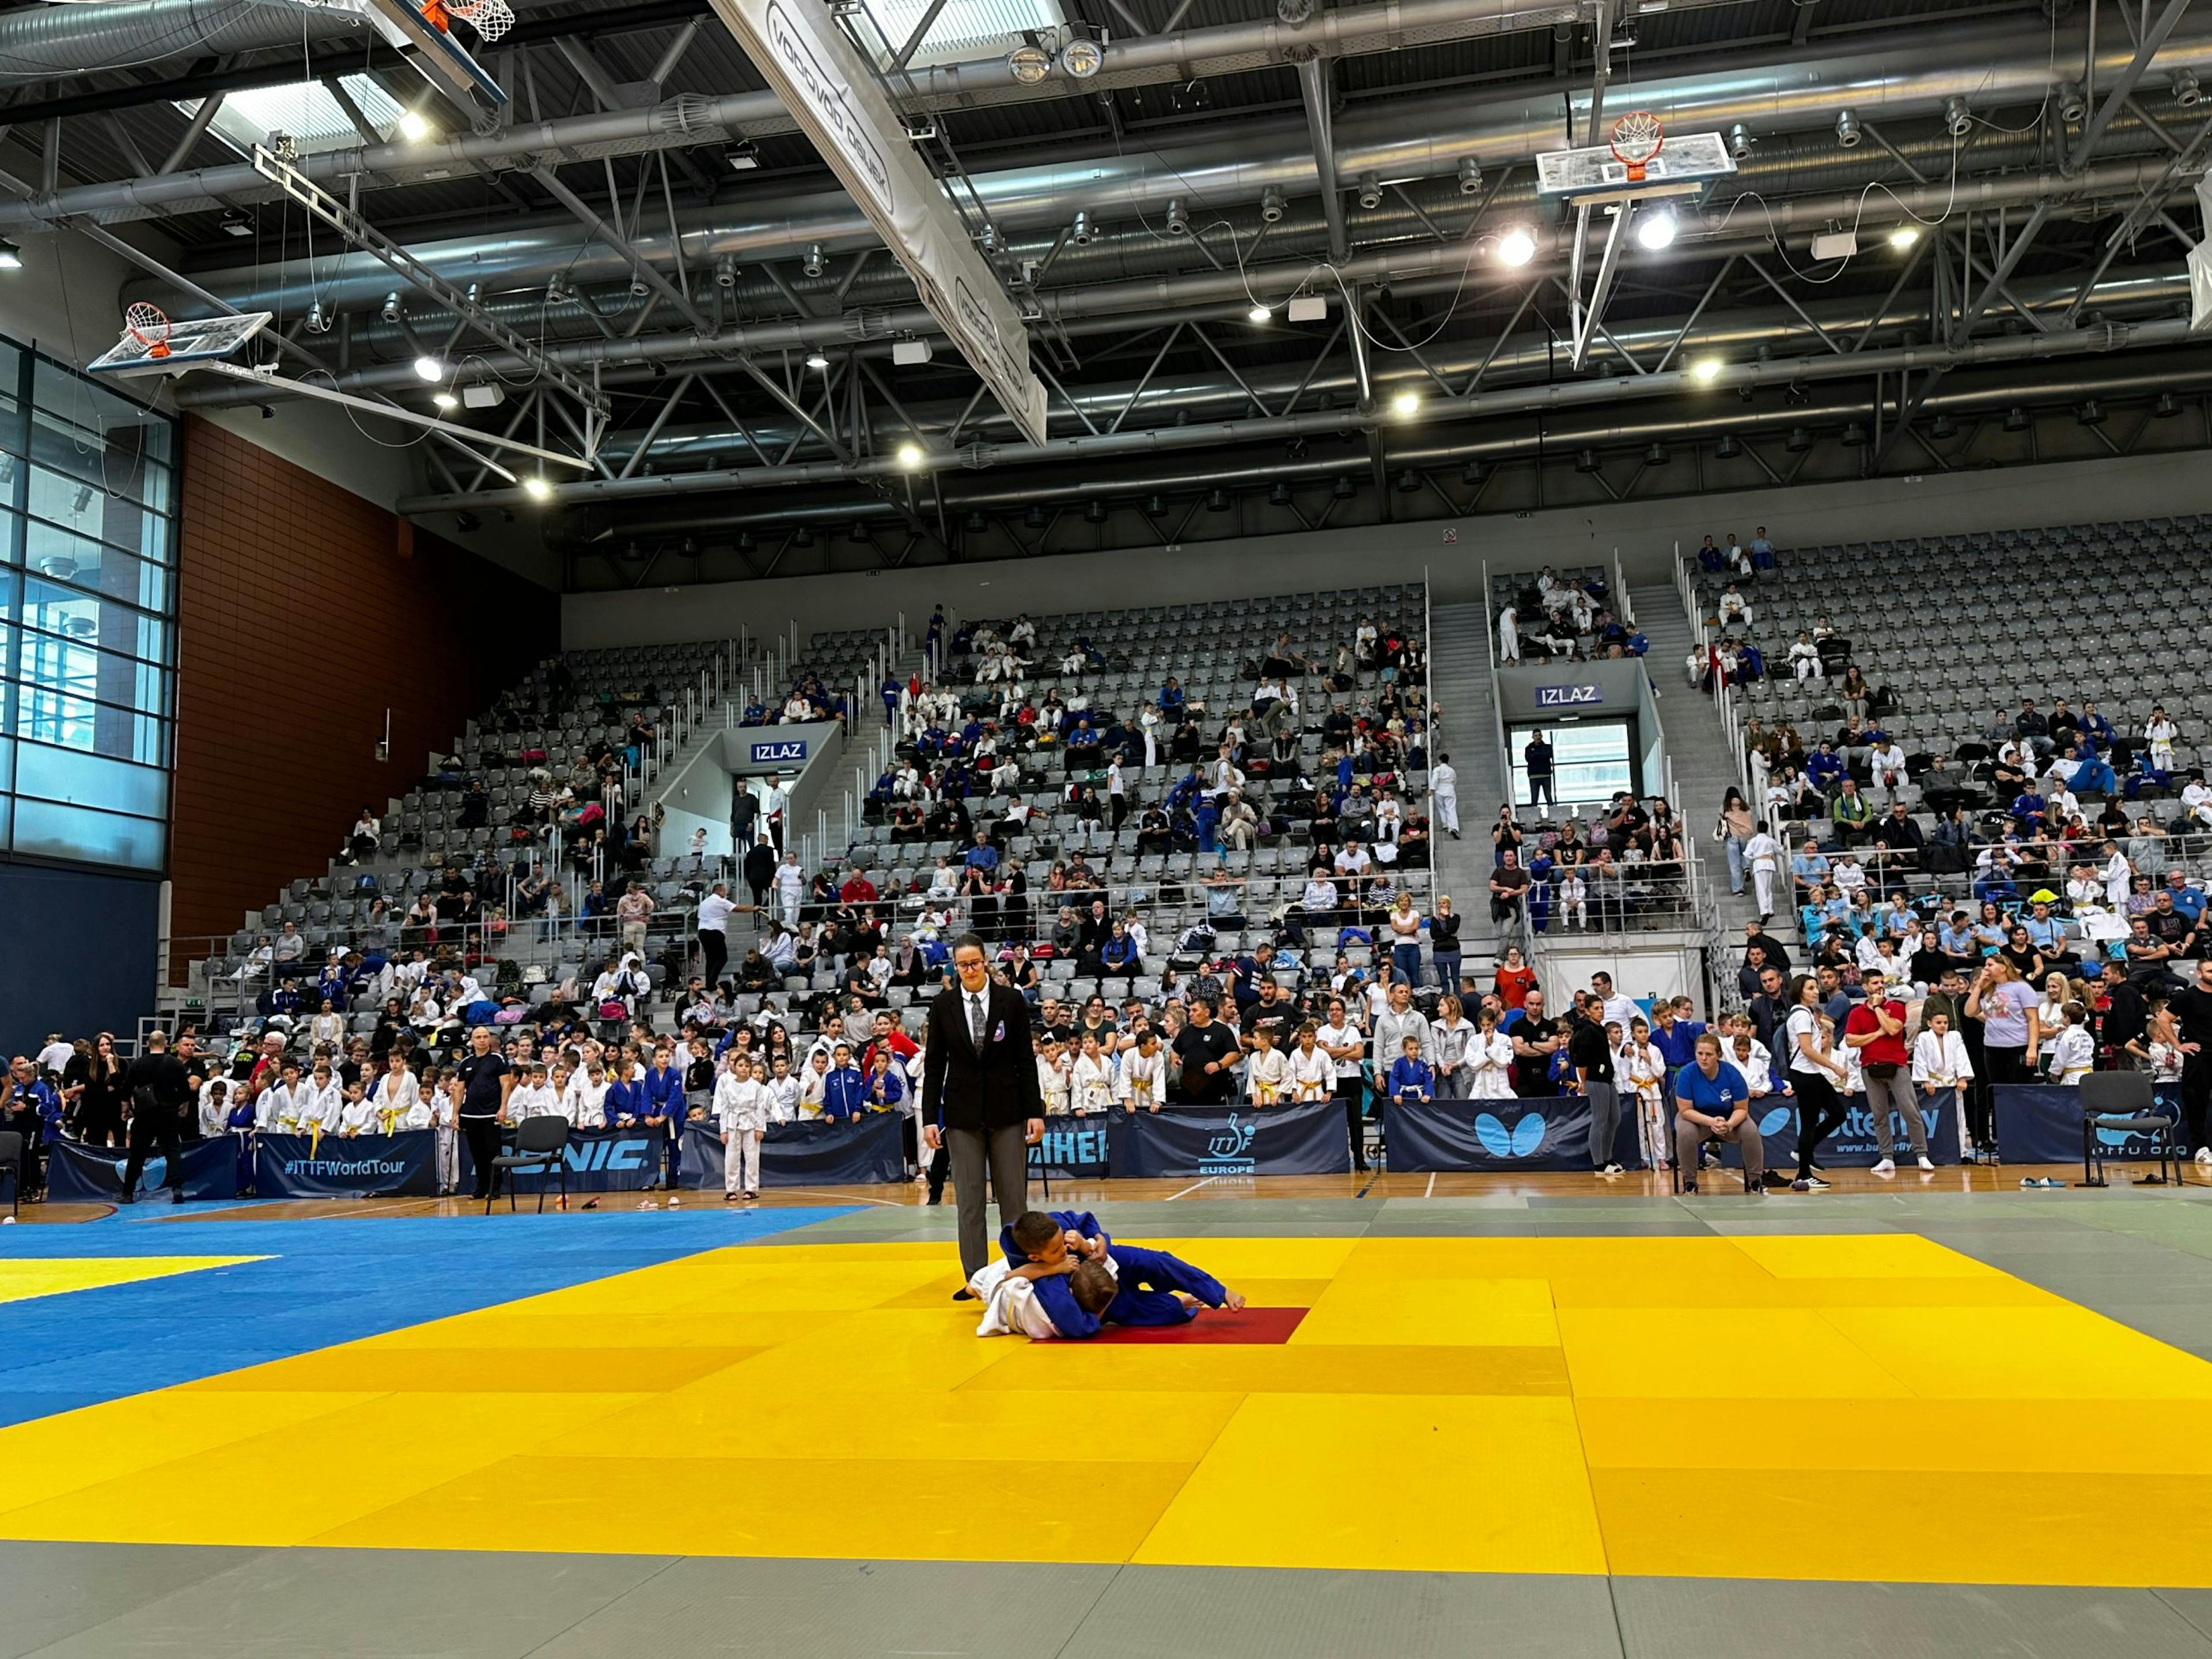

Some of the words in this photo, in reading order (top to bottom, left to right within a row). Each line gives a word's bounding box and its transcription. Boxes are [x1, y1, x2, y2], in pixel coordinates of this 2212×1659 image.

[1541, 686, 1596, 704] IZLAZ
[756, 744, 801, 760] IZLAZ
[1207, 1137, 1253, 1151] ITTF
[285, 1160, 406, 1176] #ITTFWorldTour
[1199, 1165, 1255, 1174] EUROPE
